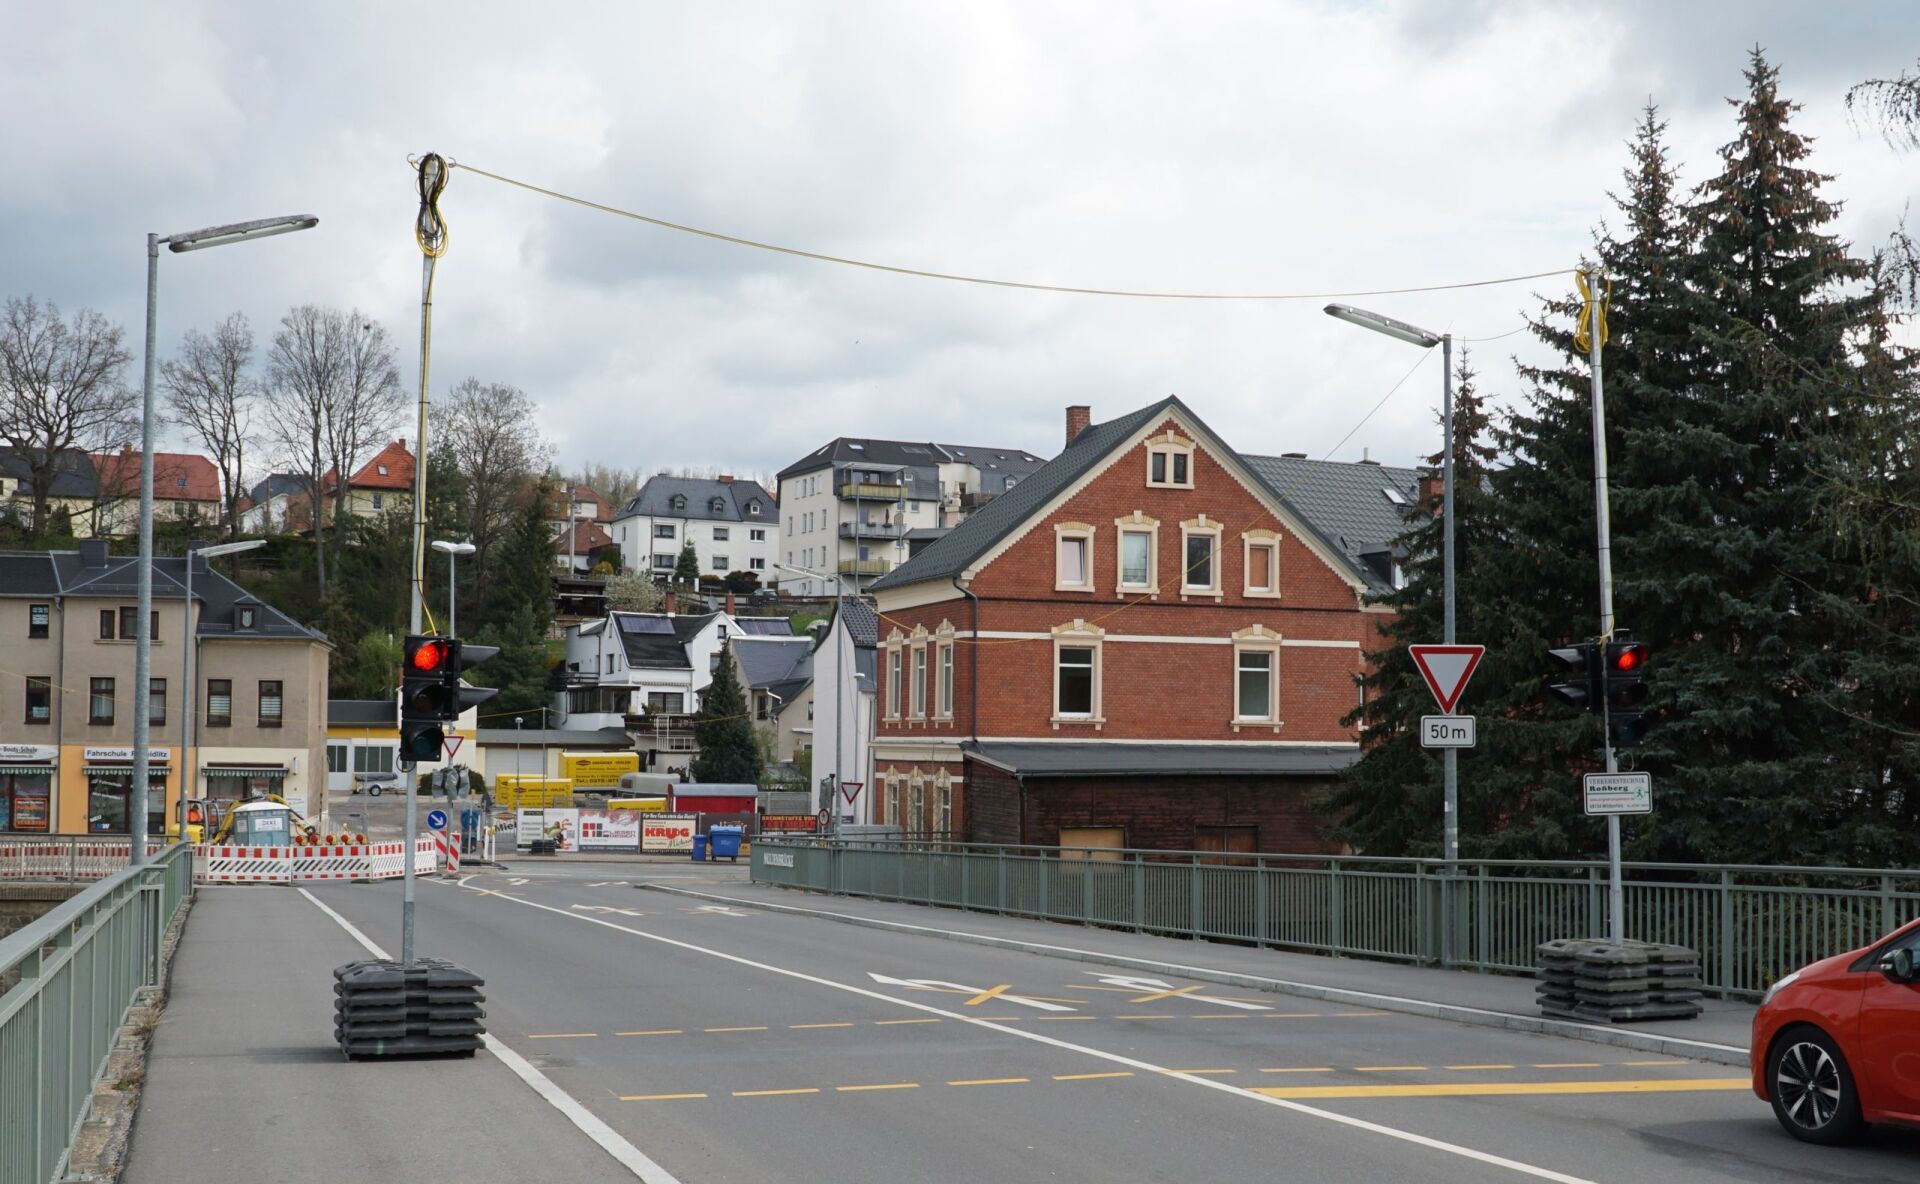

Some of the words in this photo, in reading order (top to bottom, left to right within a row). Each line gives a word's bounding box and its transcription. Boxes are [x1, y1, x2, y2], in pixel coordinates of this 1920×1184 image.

[1431, 724, 1449, 739] 50
[1452, 727, 1466, 739] m
[86, 749, 127, 757] Fahrschule
